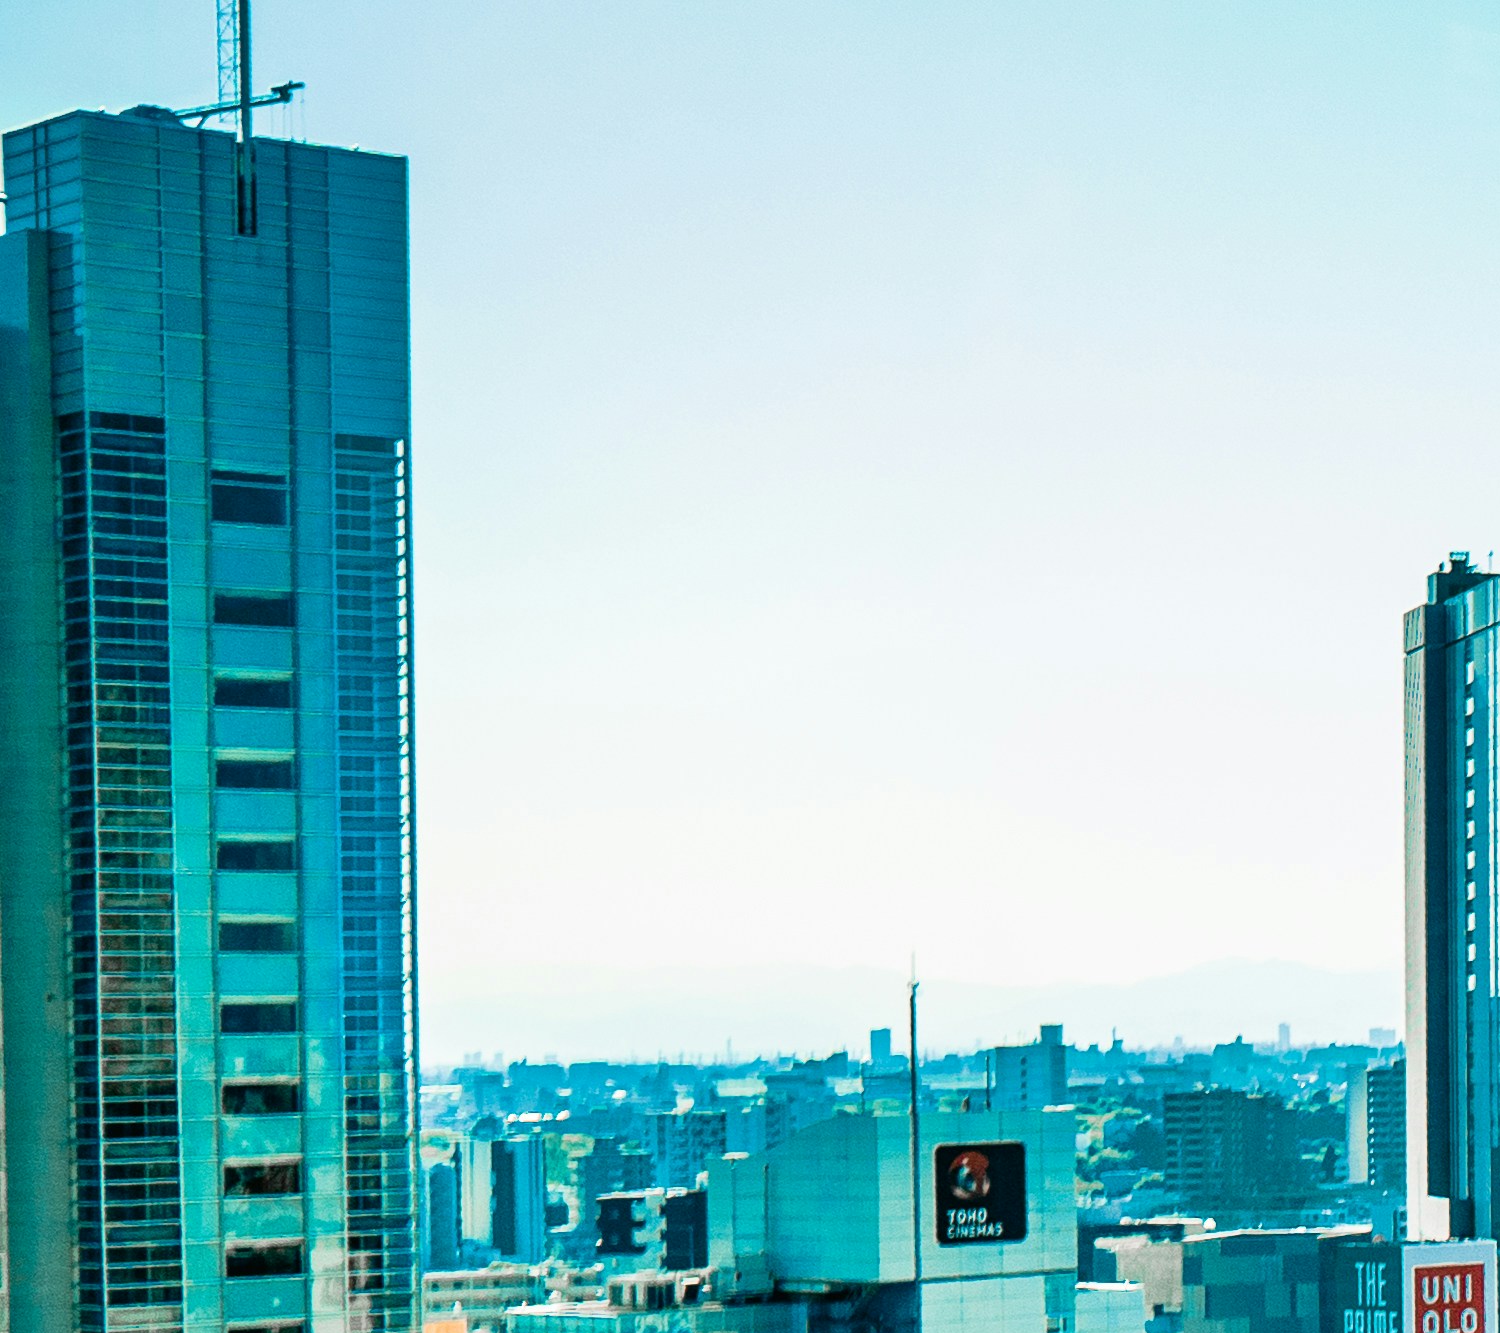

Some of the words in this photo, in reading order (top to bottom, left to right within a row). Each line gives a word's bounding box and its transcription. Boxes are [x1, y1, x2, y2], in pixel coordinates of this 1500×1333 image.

[947, 1207, 988, 1225] TOHO
[948, 1222, 1004, 1239] CINEMAS
[1355, 1262, 1387, 1307] THE
[1421, 1273, 1473, 1305] UNI
